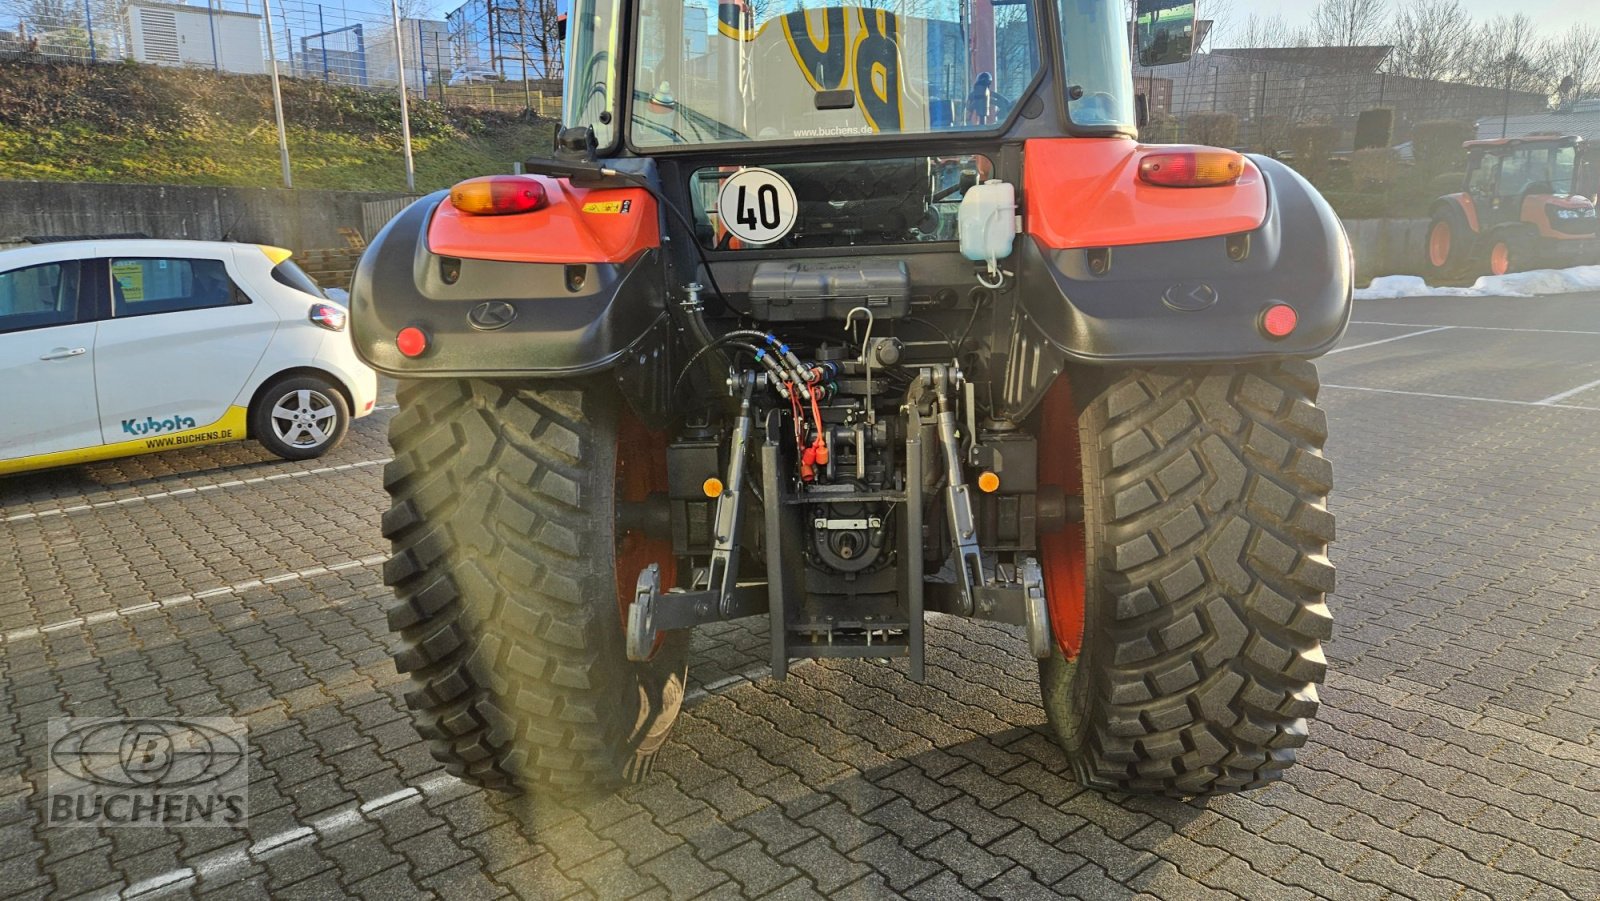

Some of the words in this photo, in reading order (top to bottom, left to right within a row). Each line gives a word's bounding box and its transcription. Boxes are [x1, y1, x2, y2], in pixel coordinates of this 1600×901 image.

[793, 125, 873, 137] www.buchens.de
[735, 183, 781, 231] 40
[121, 415, 196, 436] Kubota
[146, 429, 233, 448] WWW.BUCHENS.DE
